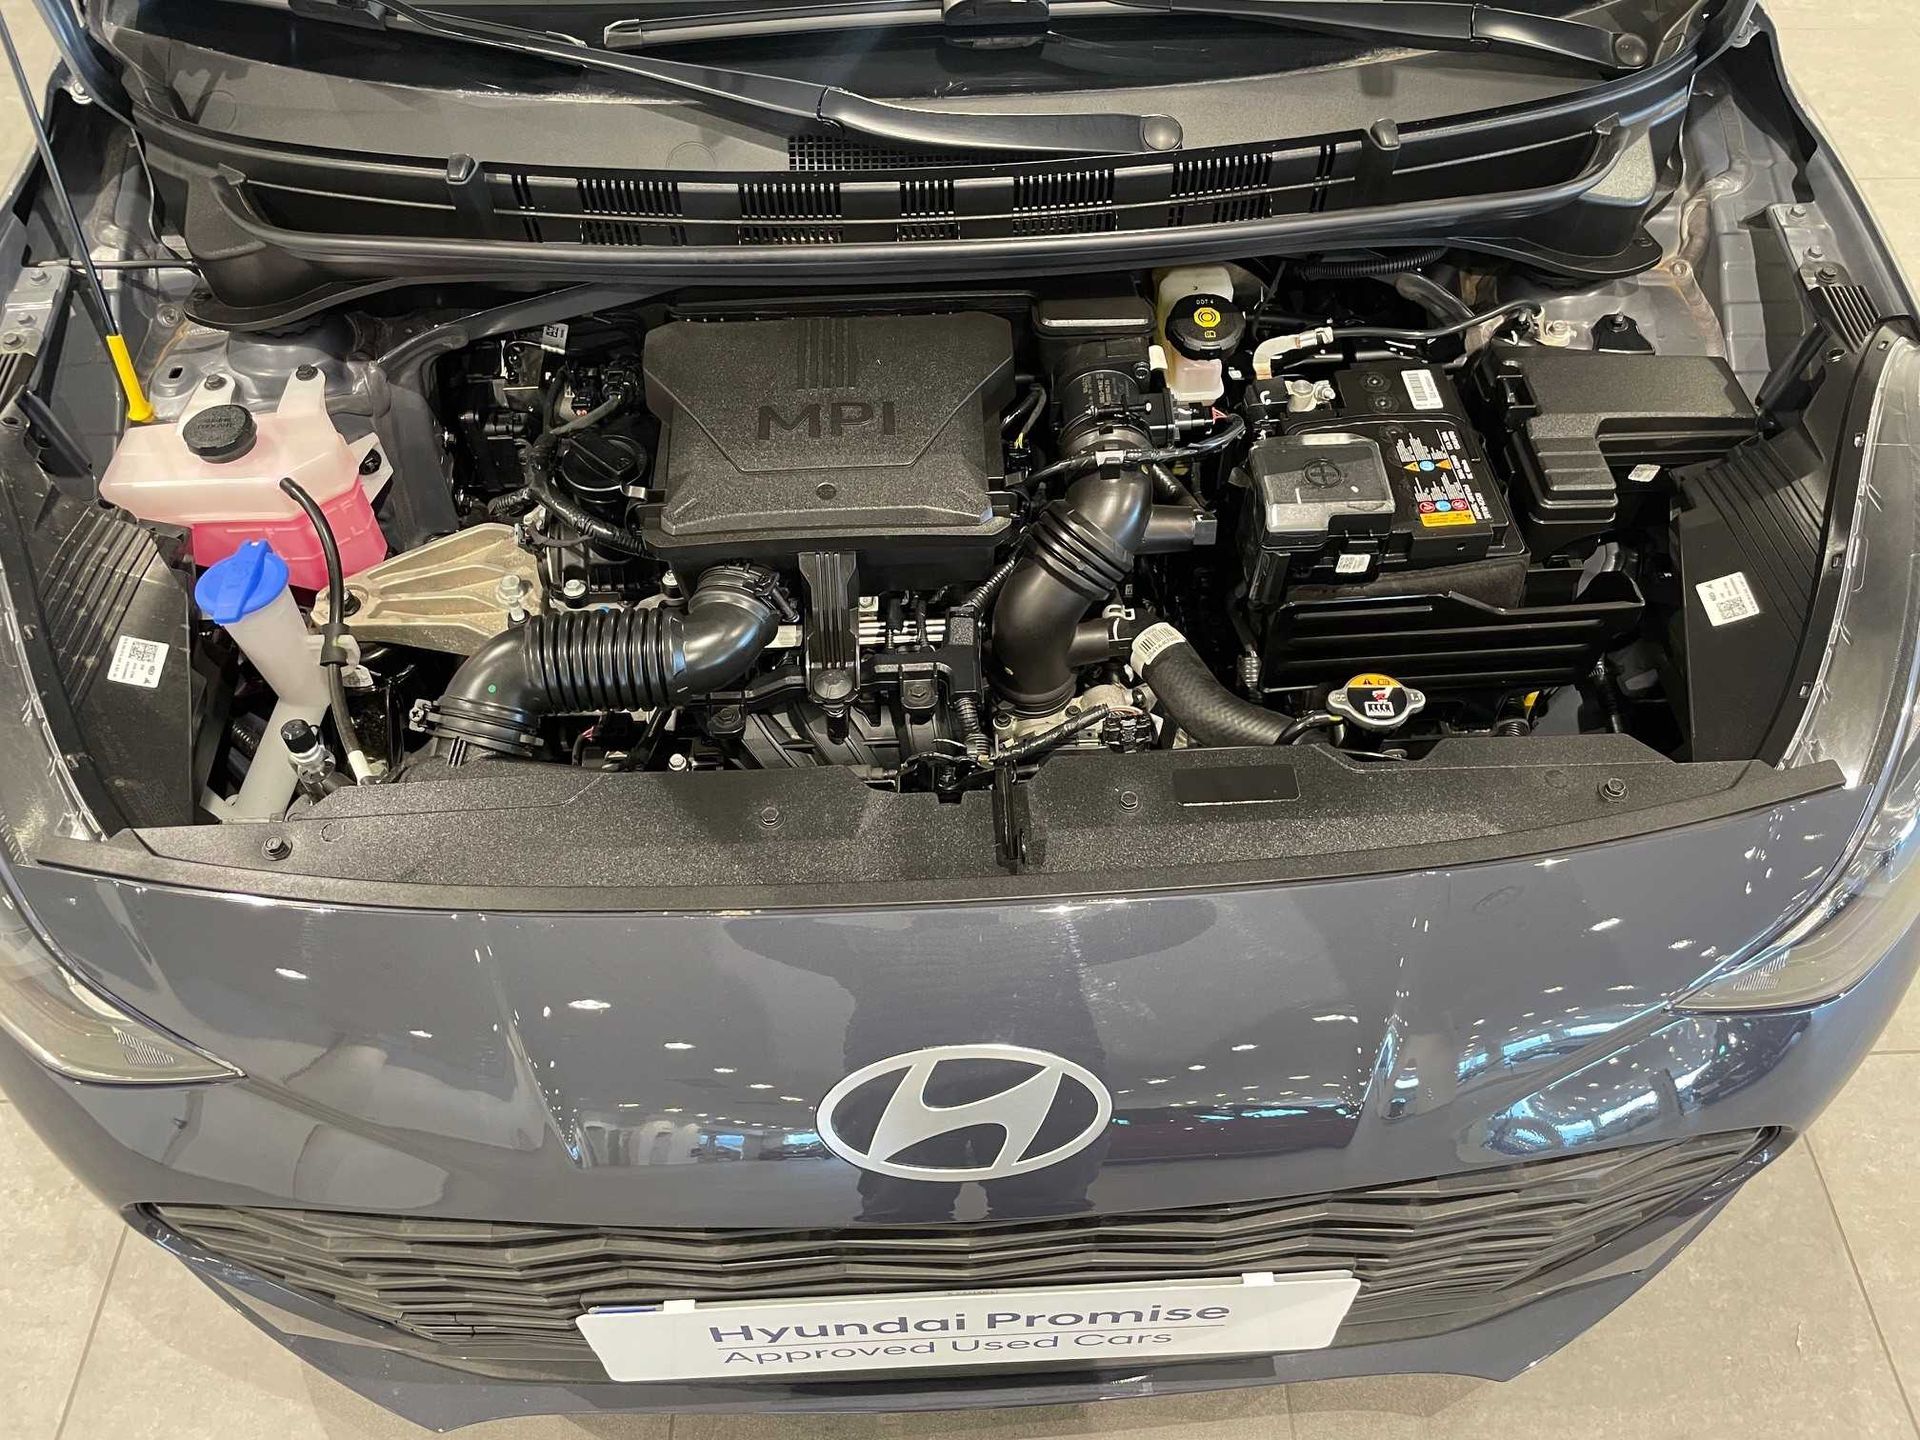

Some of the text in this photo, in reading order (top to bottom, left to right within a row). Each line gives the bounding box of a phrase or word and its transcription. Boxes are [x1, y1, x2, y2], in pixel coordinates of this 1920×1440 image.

[757, 401, 896, 441] MPI
[709, 1303, 1231, 1343] Hyundai Promise
[724, 1328, 1173, 1365] Approved Used Cars
